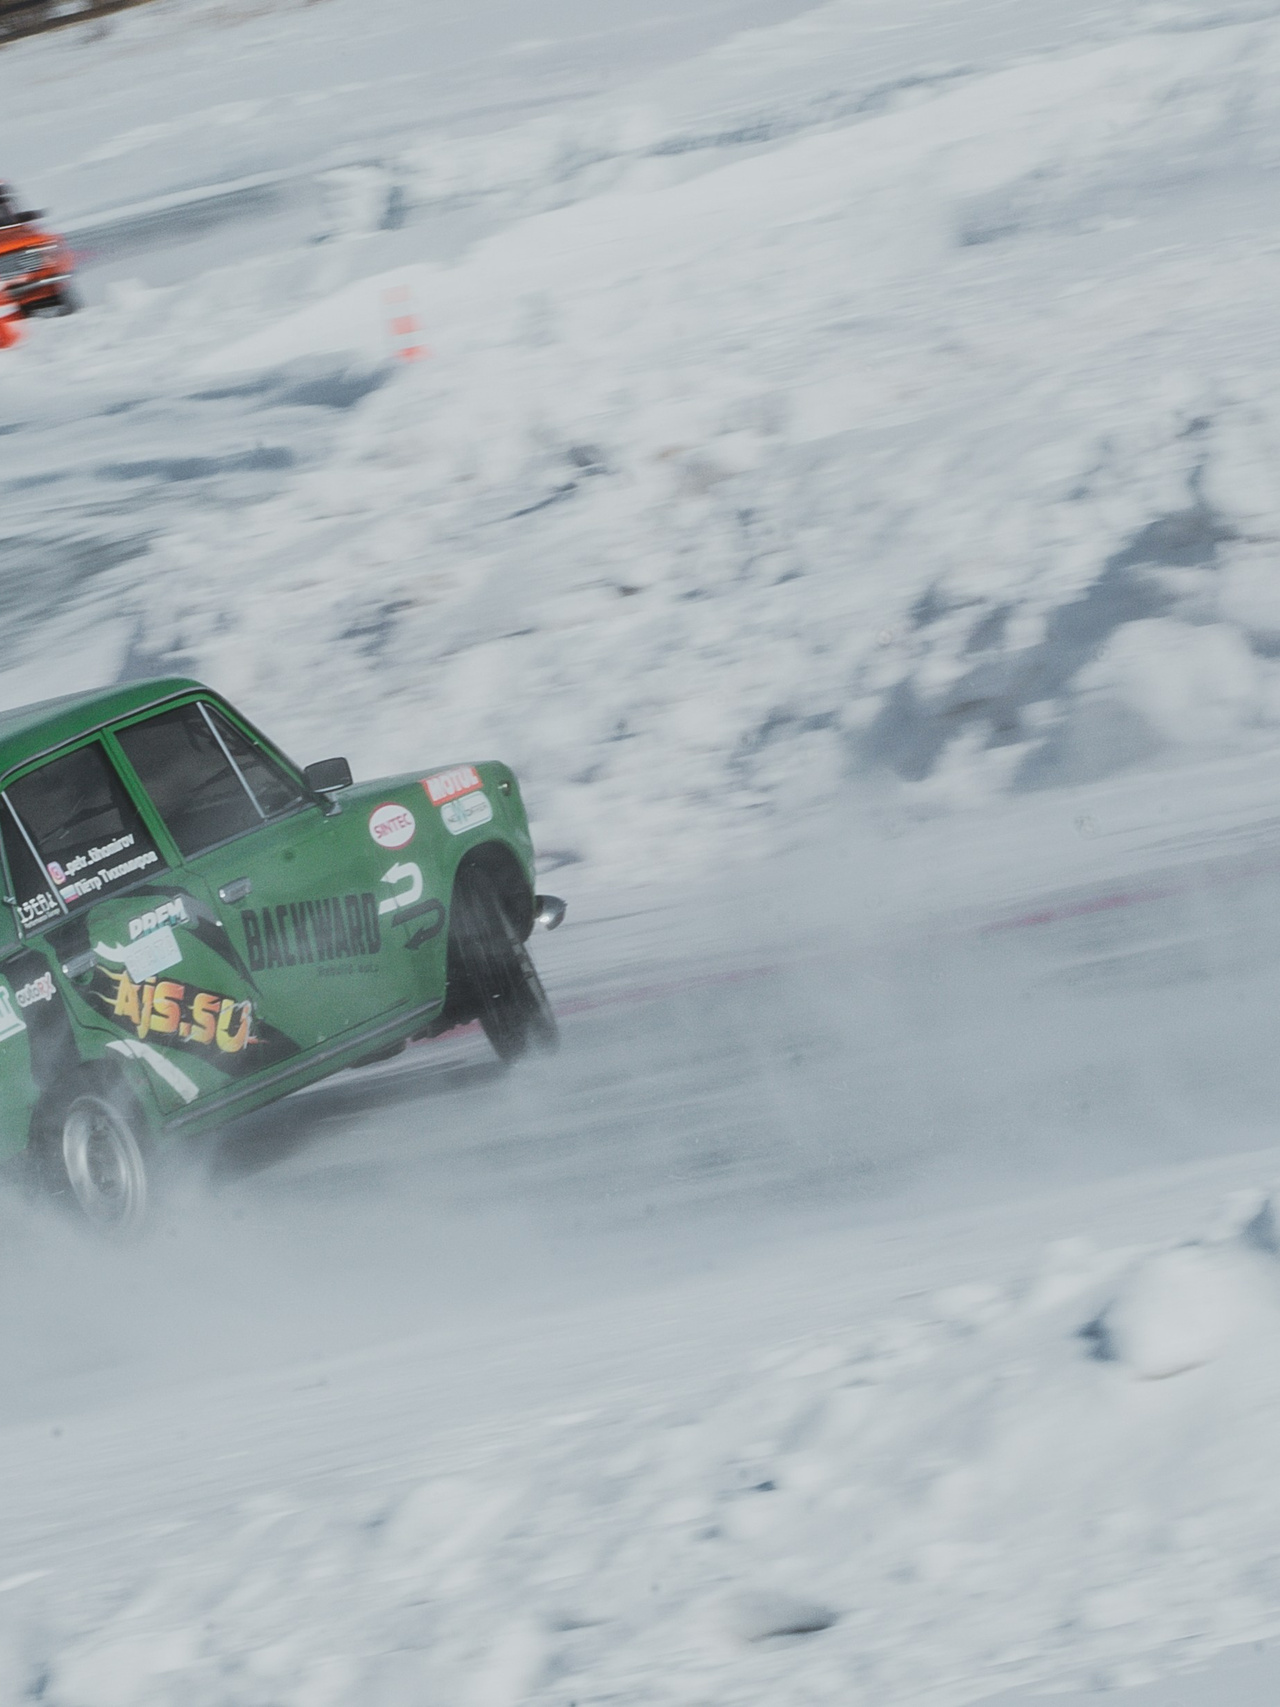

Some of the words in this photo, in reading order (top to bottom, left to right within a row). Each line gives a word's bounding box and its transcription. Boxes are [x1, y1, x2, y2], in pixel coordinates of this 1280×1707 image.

[426, 766, 479, 802] MOTUL
[373, 813, 412, 839] SINTEC
[241, 892, 381, 972] BACKWARD
